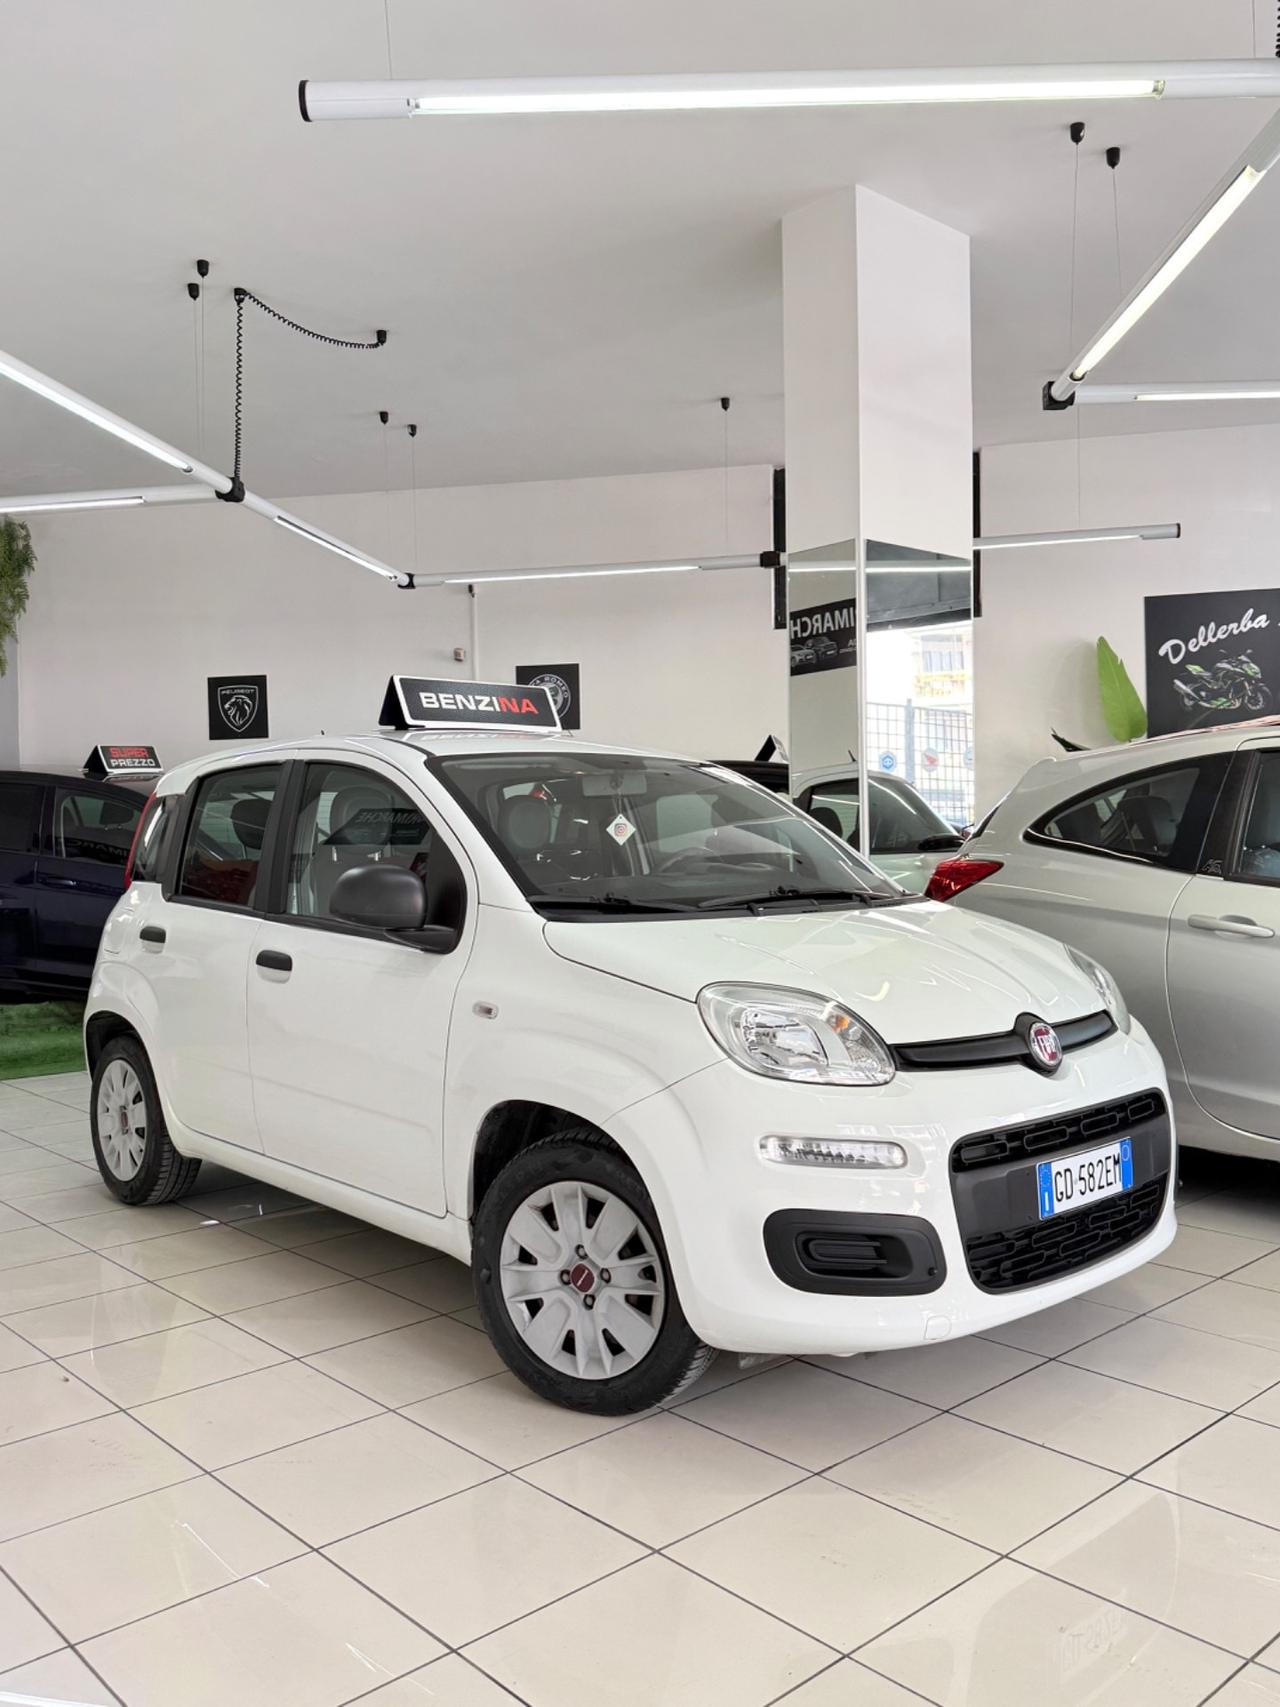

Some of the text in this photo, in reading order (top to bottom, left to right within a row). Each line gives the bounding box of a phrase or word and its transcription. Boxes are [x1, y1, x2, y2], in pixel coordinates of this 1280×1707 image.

[1158, 607, 1270, 665] Dellerba
[418, 691, 539, 715] BENZINA
[110, 747, 149, 758] SUPER
[110, 758, 156, 767] PREZZO
